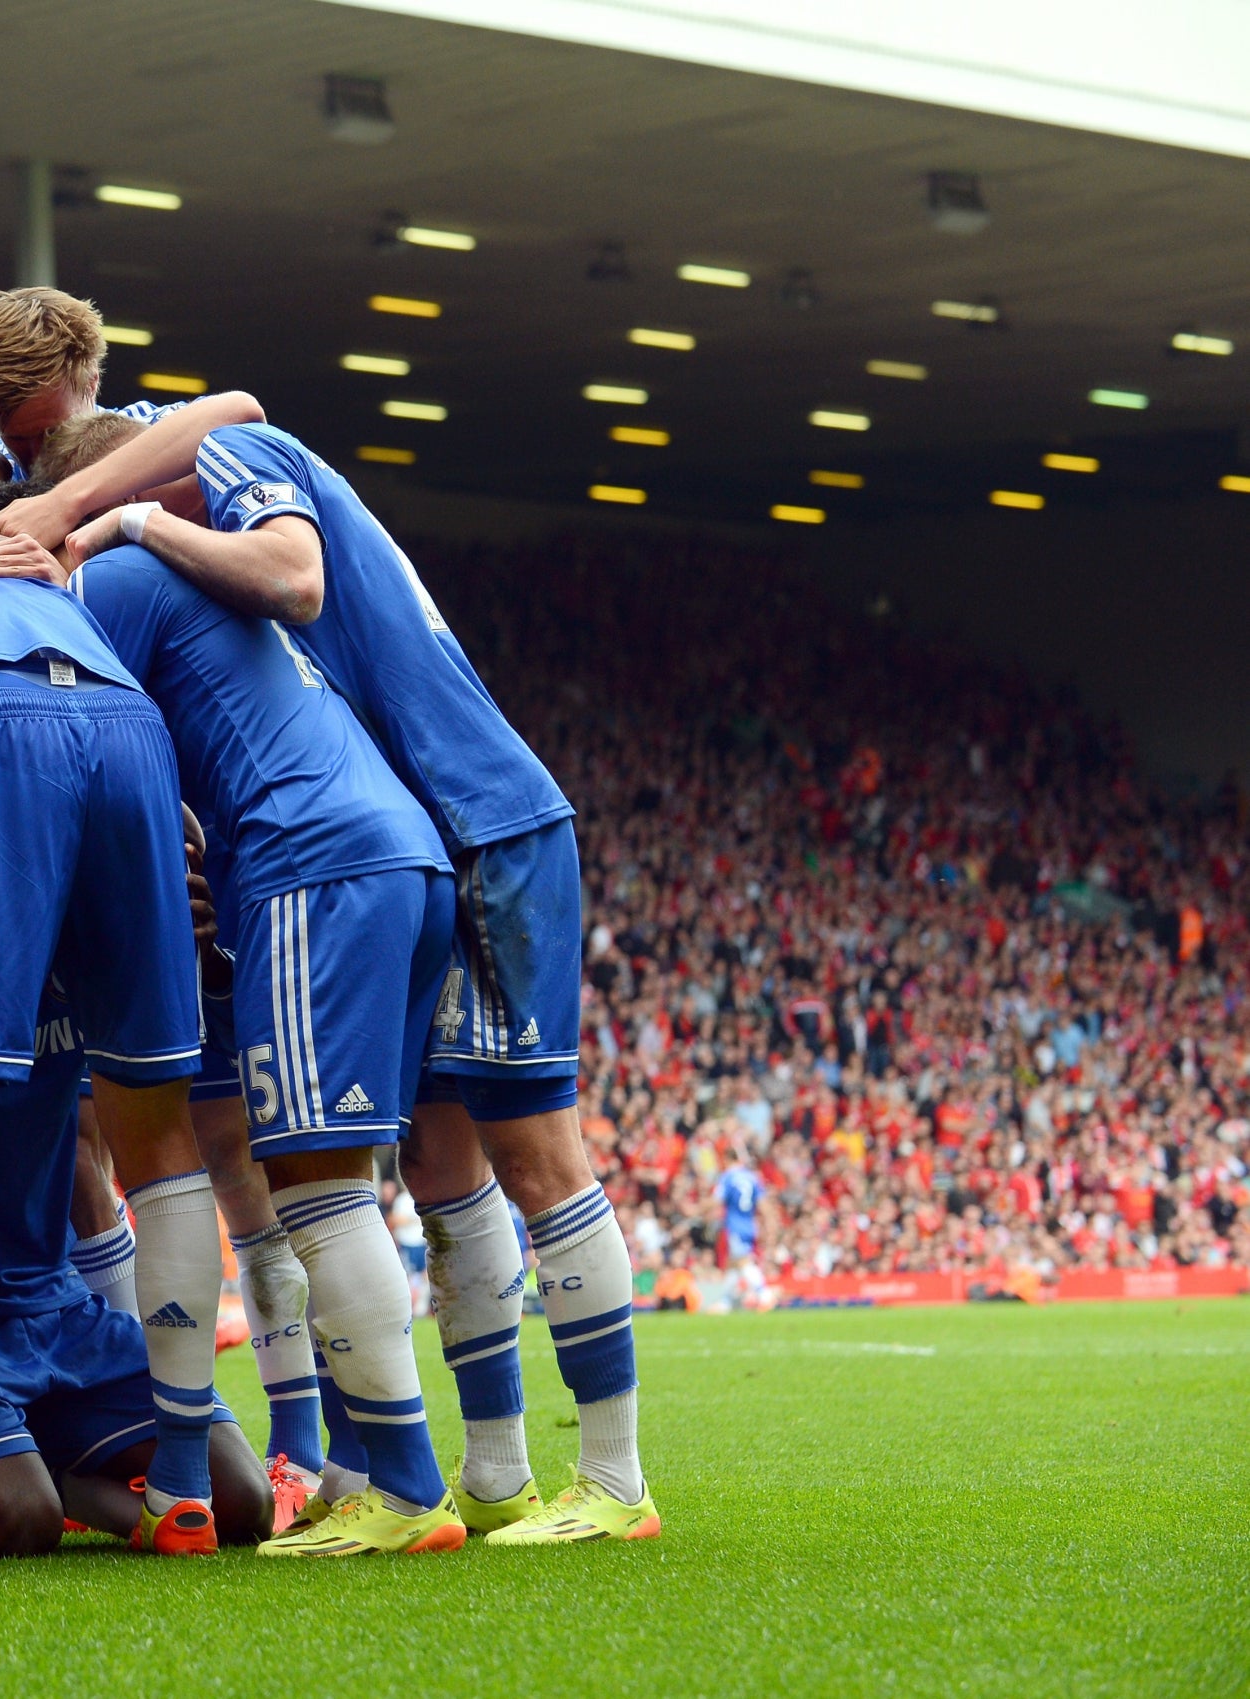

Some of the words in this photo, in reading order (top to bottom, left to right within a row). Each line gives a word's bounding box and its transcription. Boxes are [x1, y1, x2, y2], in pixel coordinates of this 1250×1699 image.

[517, 1033, 541, 1046] adidas
[238, 1043, 279, 1128] 5
[335, 1101, 375, 1113] adidas
[145, 1315, 198, 1329] adidas
